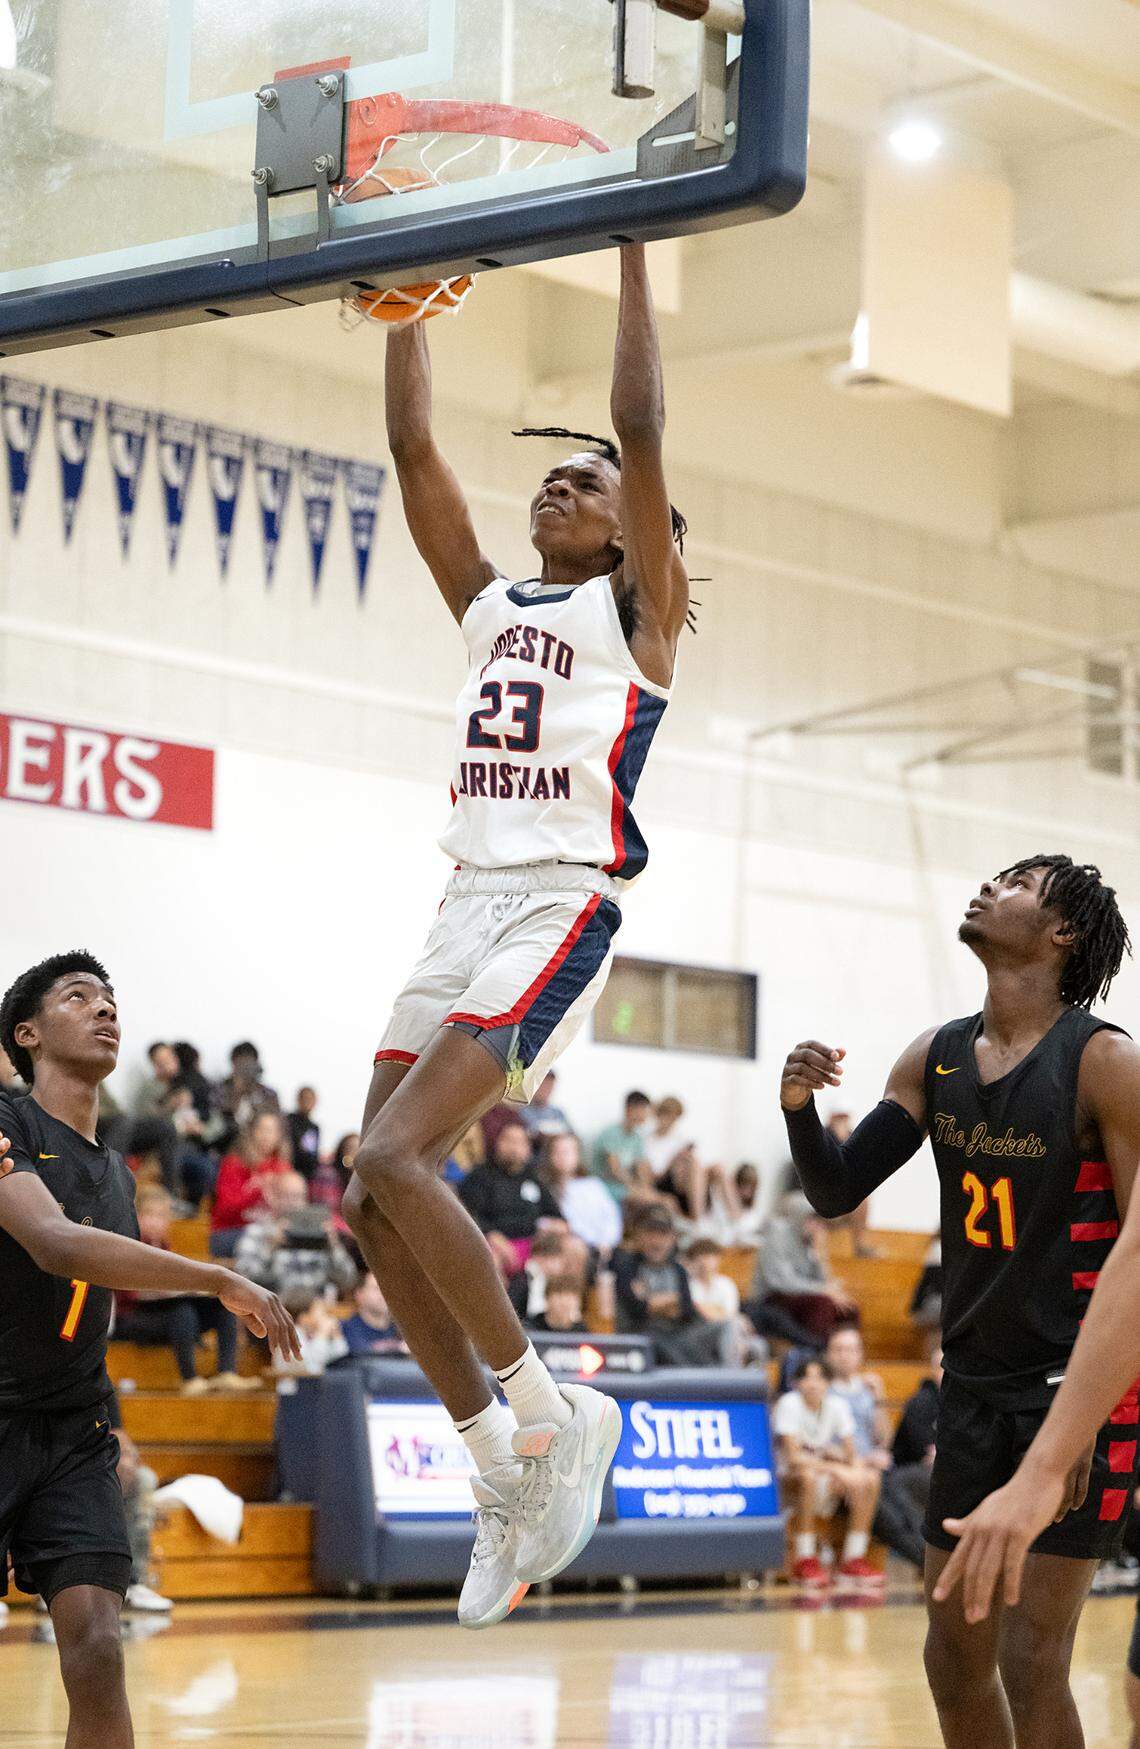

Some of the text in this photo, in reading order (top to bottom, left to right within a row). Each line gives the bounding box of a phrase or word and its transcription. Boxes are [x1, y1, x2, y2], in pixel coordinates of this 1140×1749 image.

[466, 680, 544, 753] 23
[0, 718, 162, 820] ERS
[459, 762, 571, 800] RISTIAN
[935, 1112, 1046, 1157] The Jackets
[962, 1170, 1015, 1251] 21
[59, 1279, 88, 1342] 1
